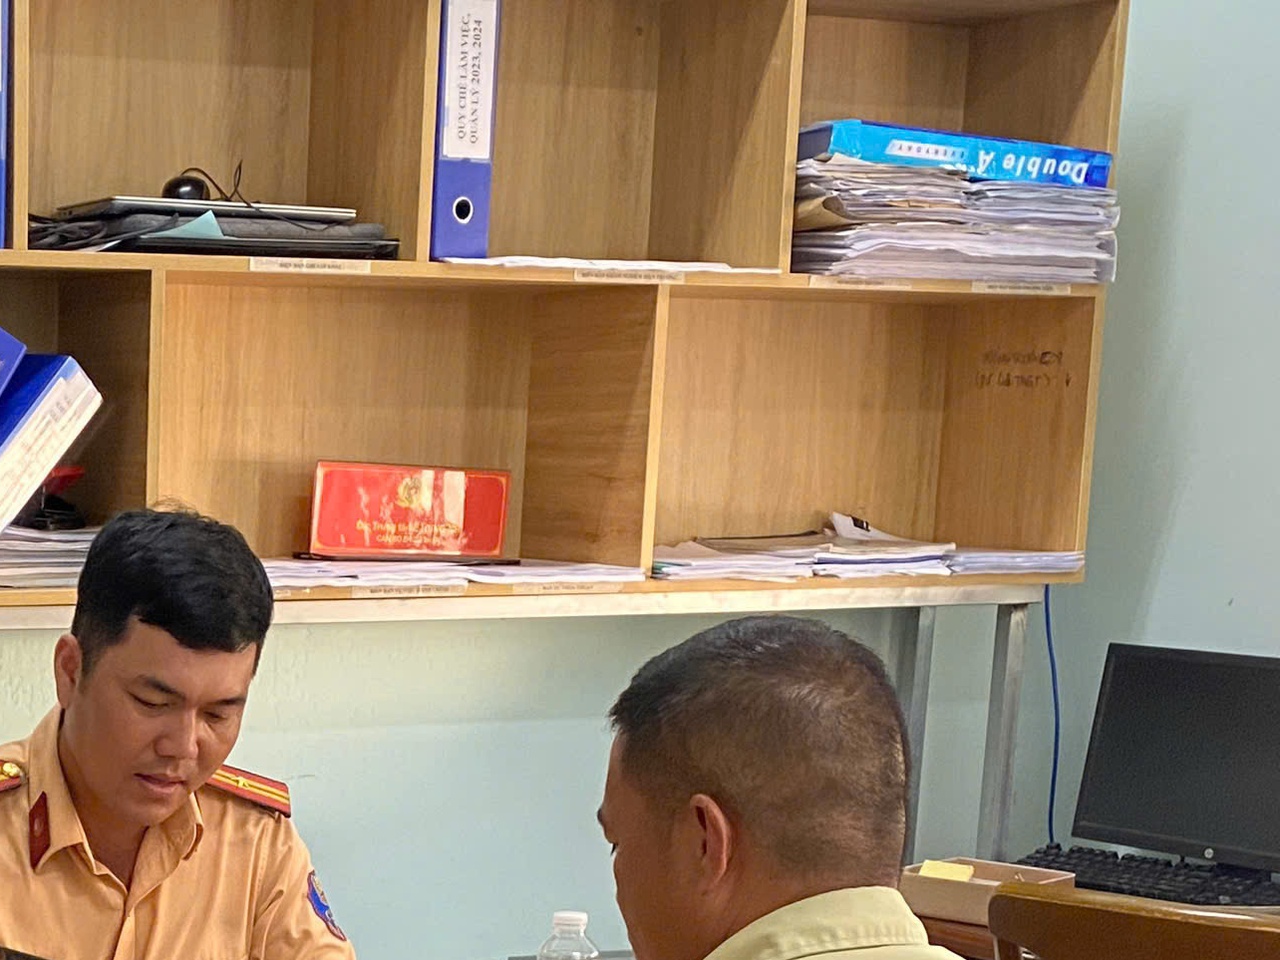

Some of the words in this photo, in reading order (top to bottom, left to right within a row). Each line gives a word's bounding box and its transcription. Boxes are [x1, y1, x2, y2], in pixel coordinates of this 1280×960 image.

[472, 20, 482, 47] 2024
[978, 150, 997, 175] A
[1001, 151, 1089, 184] Double
